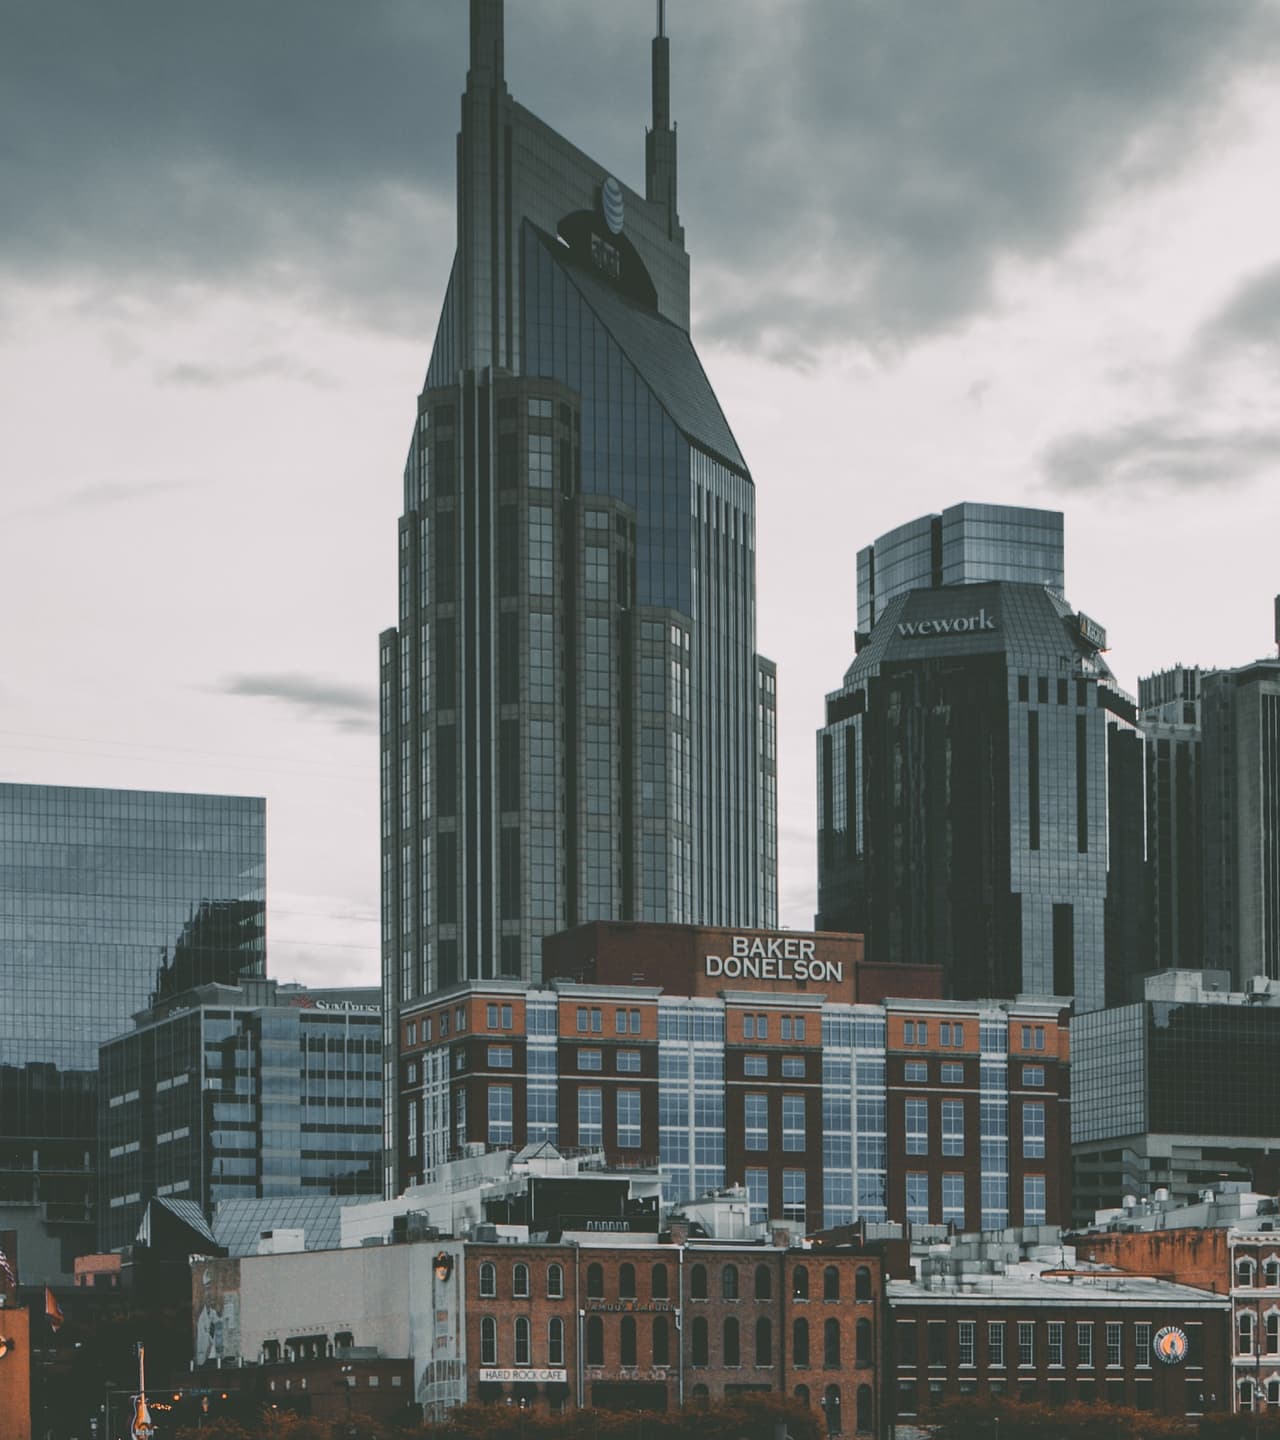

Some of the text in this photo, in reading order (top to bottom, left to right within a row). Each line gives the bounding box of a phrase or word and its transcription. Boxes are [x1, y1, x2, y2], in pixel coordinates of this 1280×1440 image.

[897, 608, 995, 637] wework
[732, 936, 816, 960] BAKER
[705, 955, 843, 983] DONELSON
[485, 1370, 563, 1380] HARD ROCK CAFE
